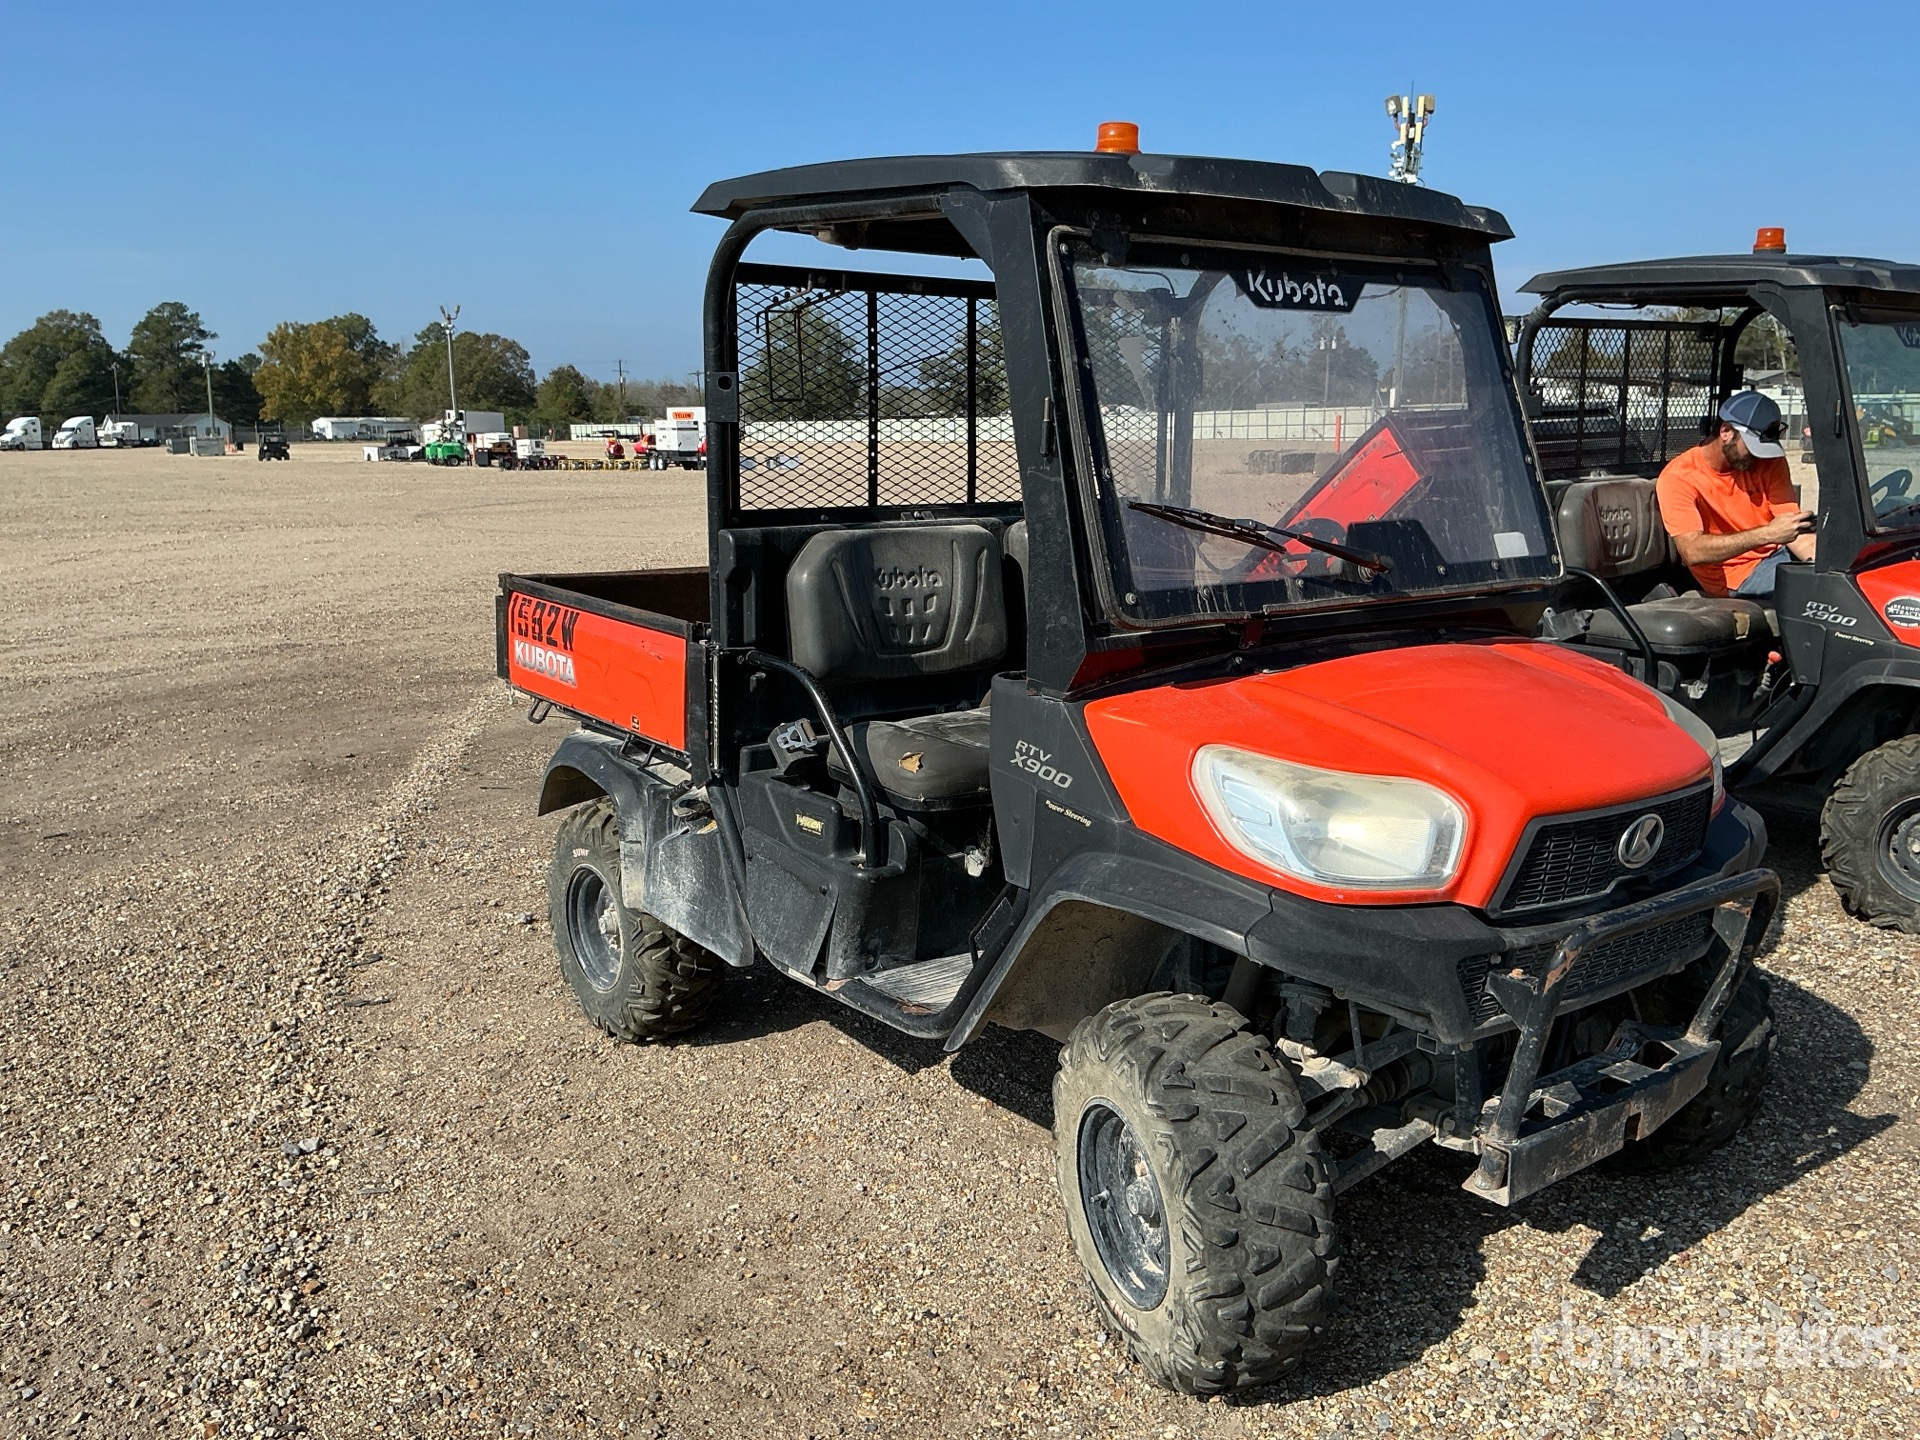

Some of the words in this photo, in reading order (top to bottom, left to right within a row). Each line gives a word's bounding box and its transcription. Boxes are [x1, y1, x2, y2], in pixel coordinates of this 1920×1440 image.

[1247, 266, 1345, 307] Kubota
[1598, 505, 1632, 523] Kubota
[872, 566, 943, 590] Kubota
[1801, 607, 1857, 627] X900
[1806, 601, 1839, 612] RTV
[514, 639, 577, 687] KUBOTA
[1015, 740, 1052, 762] RTV
[1010, 750, 1073, 789] X900
[1045, 799, 1064, 813] Power
[1064, 808, 1092, 827] Steering
